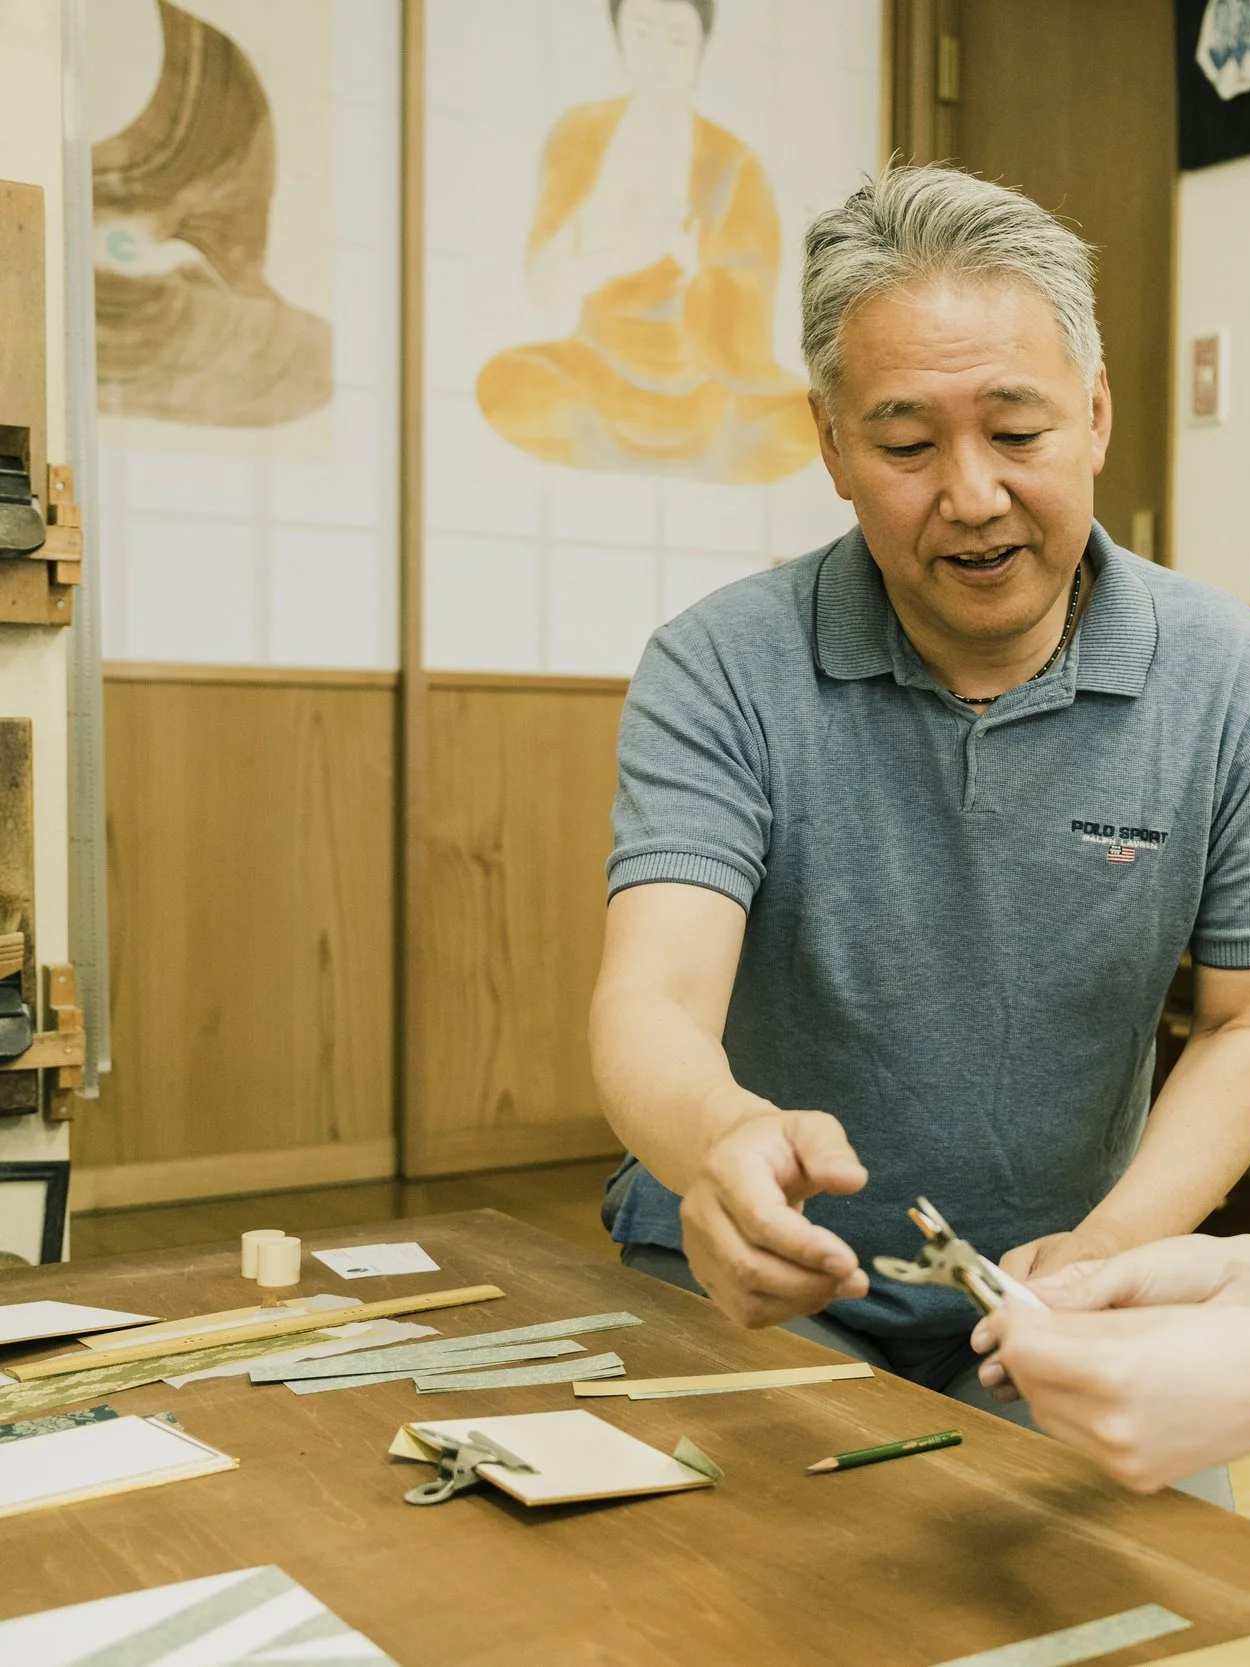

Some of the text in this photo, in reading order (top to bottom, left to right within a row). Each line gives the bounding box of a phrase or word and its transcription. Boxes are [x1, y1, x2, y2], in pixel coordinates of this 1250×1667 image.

[1071, 819, 1169, 844] POLO SPORT
[1081, 834, 1116, 845] RALPH
